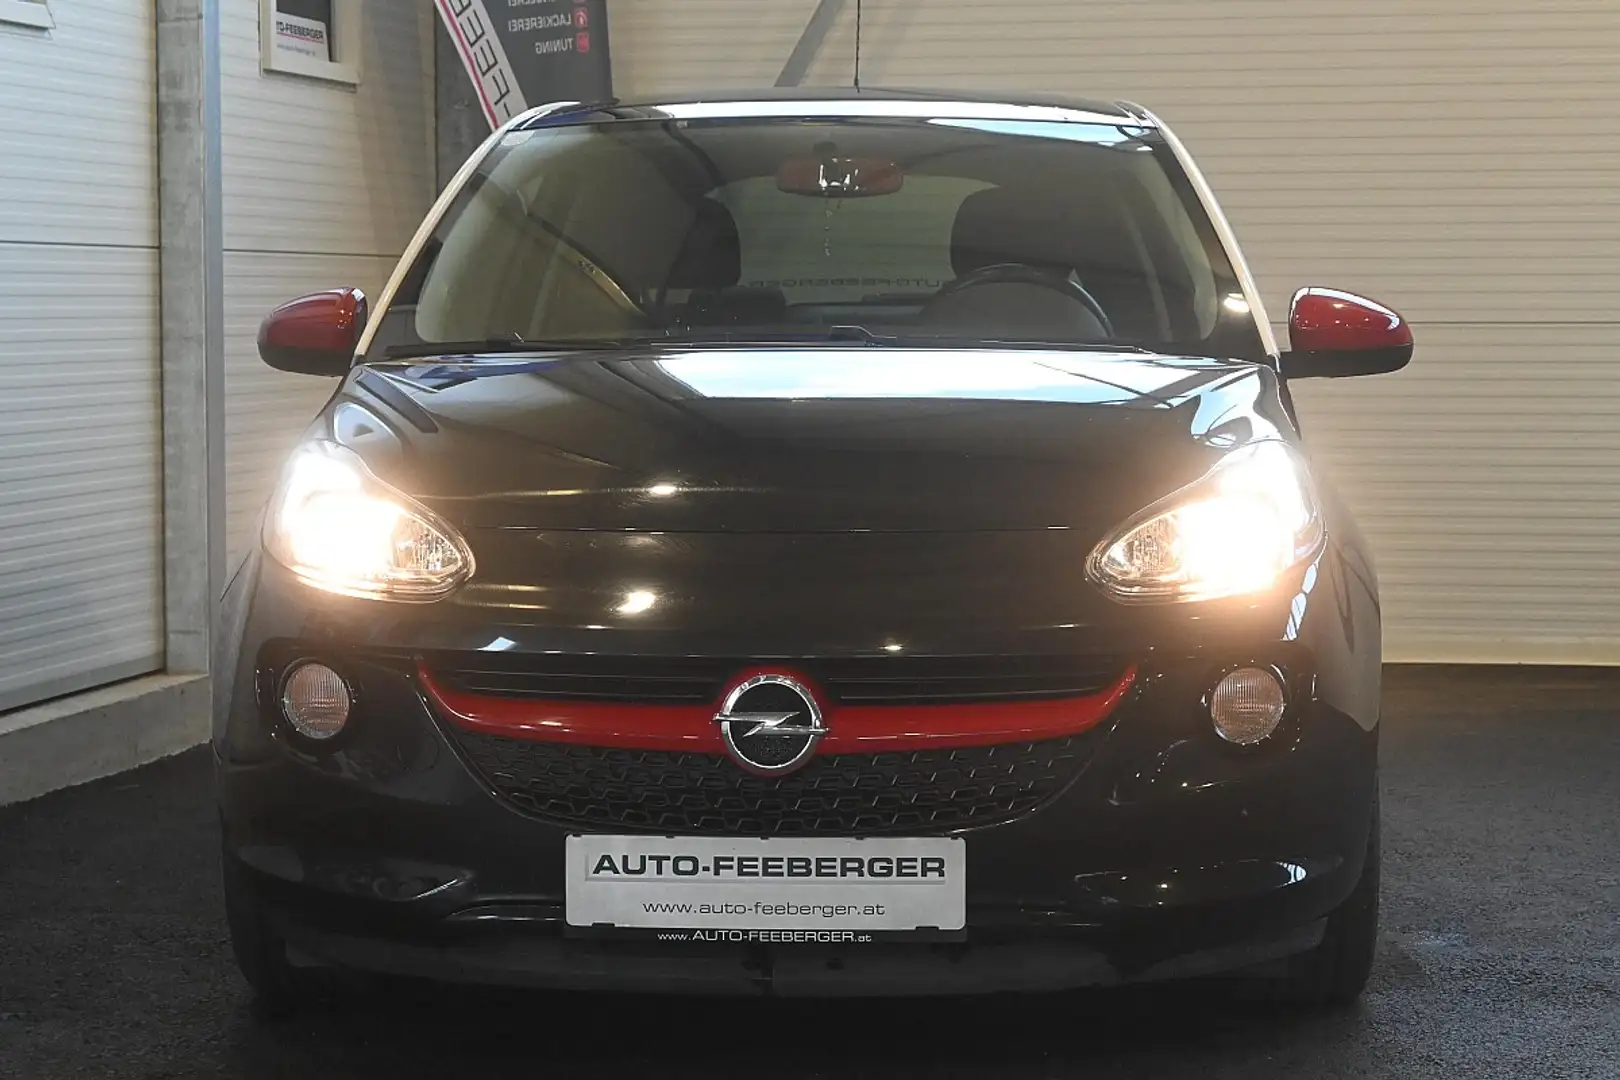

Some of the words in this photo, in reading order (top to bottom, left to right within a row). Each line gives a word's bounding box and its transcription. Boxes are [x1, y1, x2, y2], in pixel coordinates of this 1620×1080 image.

[592, 854, 946, 879] AUTO-FEEBERGER
[642, 901, 886, 918] www.auto-feeberger.at
[657, 929, 873, 943] www.AUTO-FEEBERGER.at
